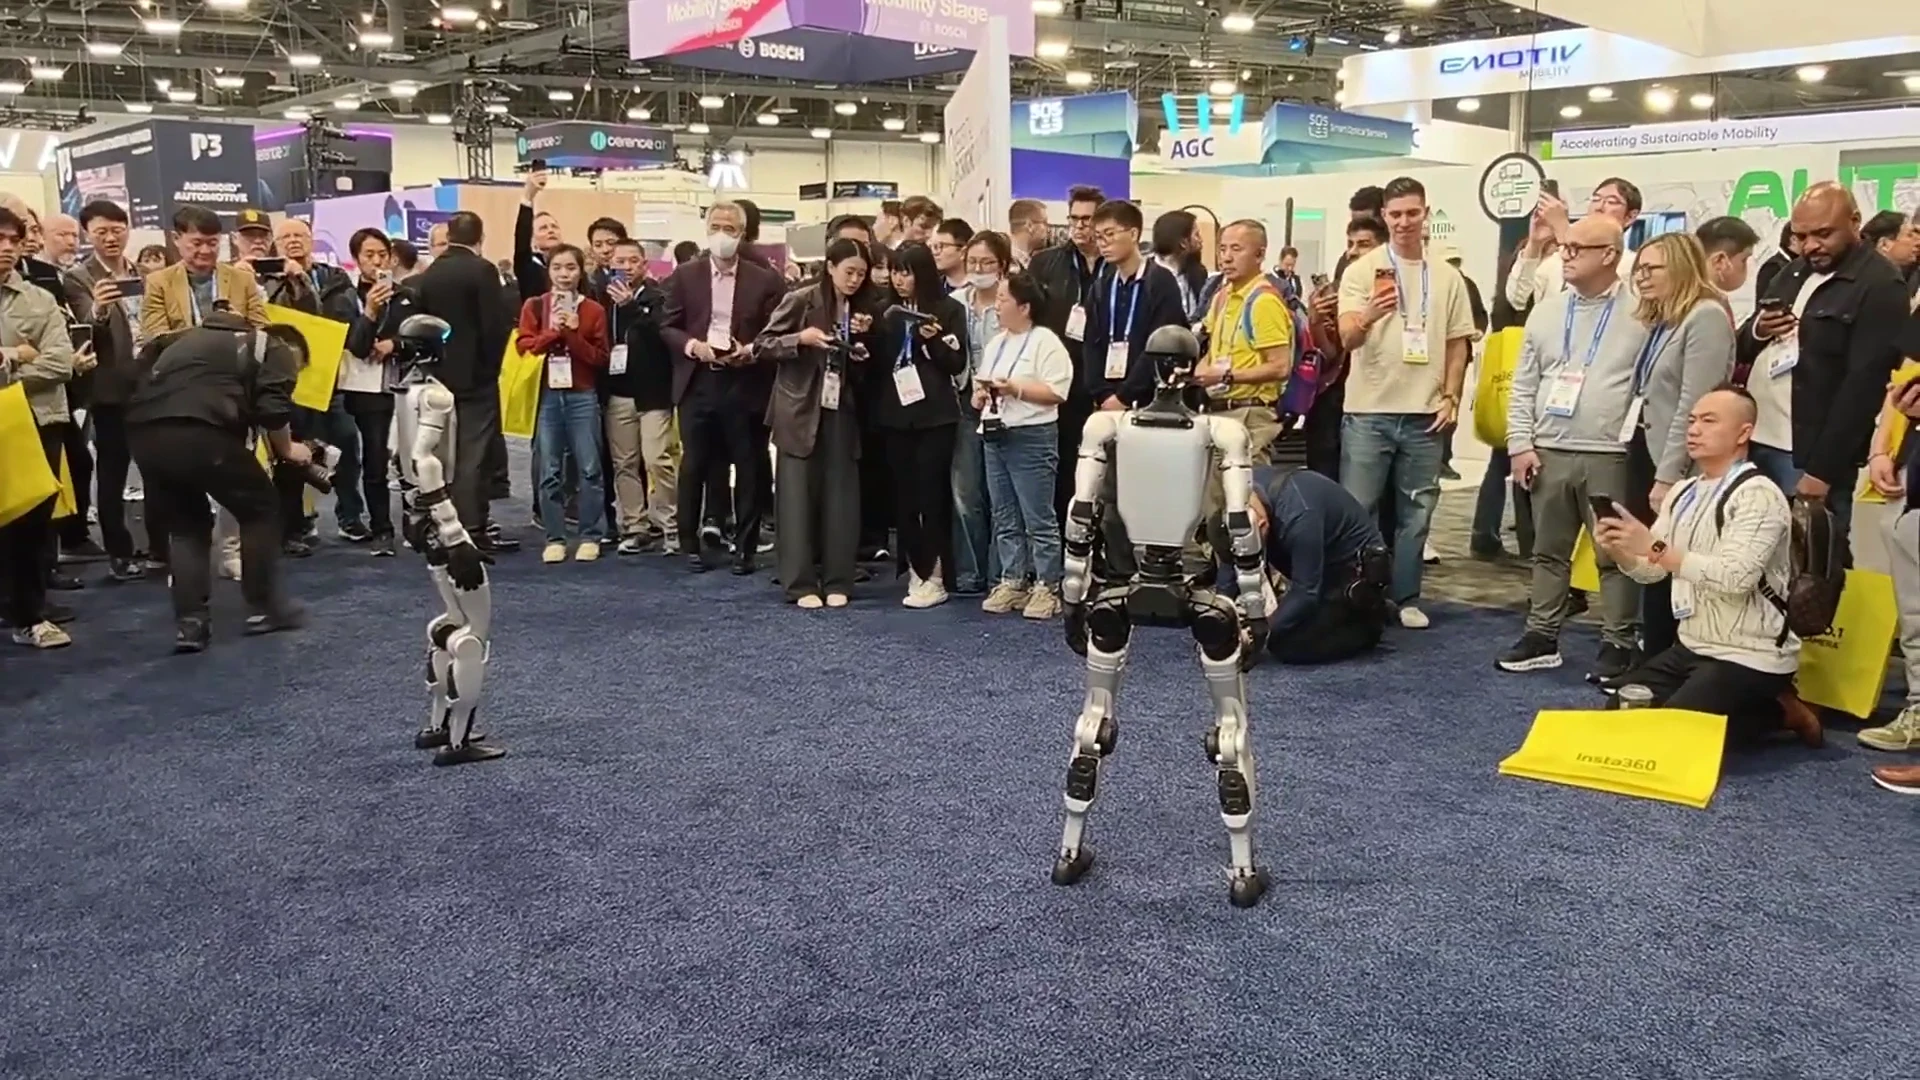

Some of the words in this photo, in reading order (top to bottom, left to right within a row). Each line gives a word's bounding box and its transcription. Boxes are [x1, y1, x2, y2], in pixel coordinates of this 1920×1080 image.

[940, 0, 988, 24] Stage
[759, 42, 805, 61] BOSCH
[1440, 43, 1581, 74] EMOTIV
[190, 132, 223, 160] P3
[607, 137, 654, 149] cerence
[1170, 137, 1214, 160] AGC
[1560, 135, 1637, 150] Accelerating
[1640, 128, 1719, 145] Sustainable
[1722, 125, 1779, 141] Mobility
[173, 191, 248, 203] AUTOMOTIVE
[1576, 752, 1657, 771] Insta360
